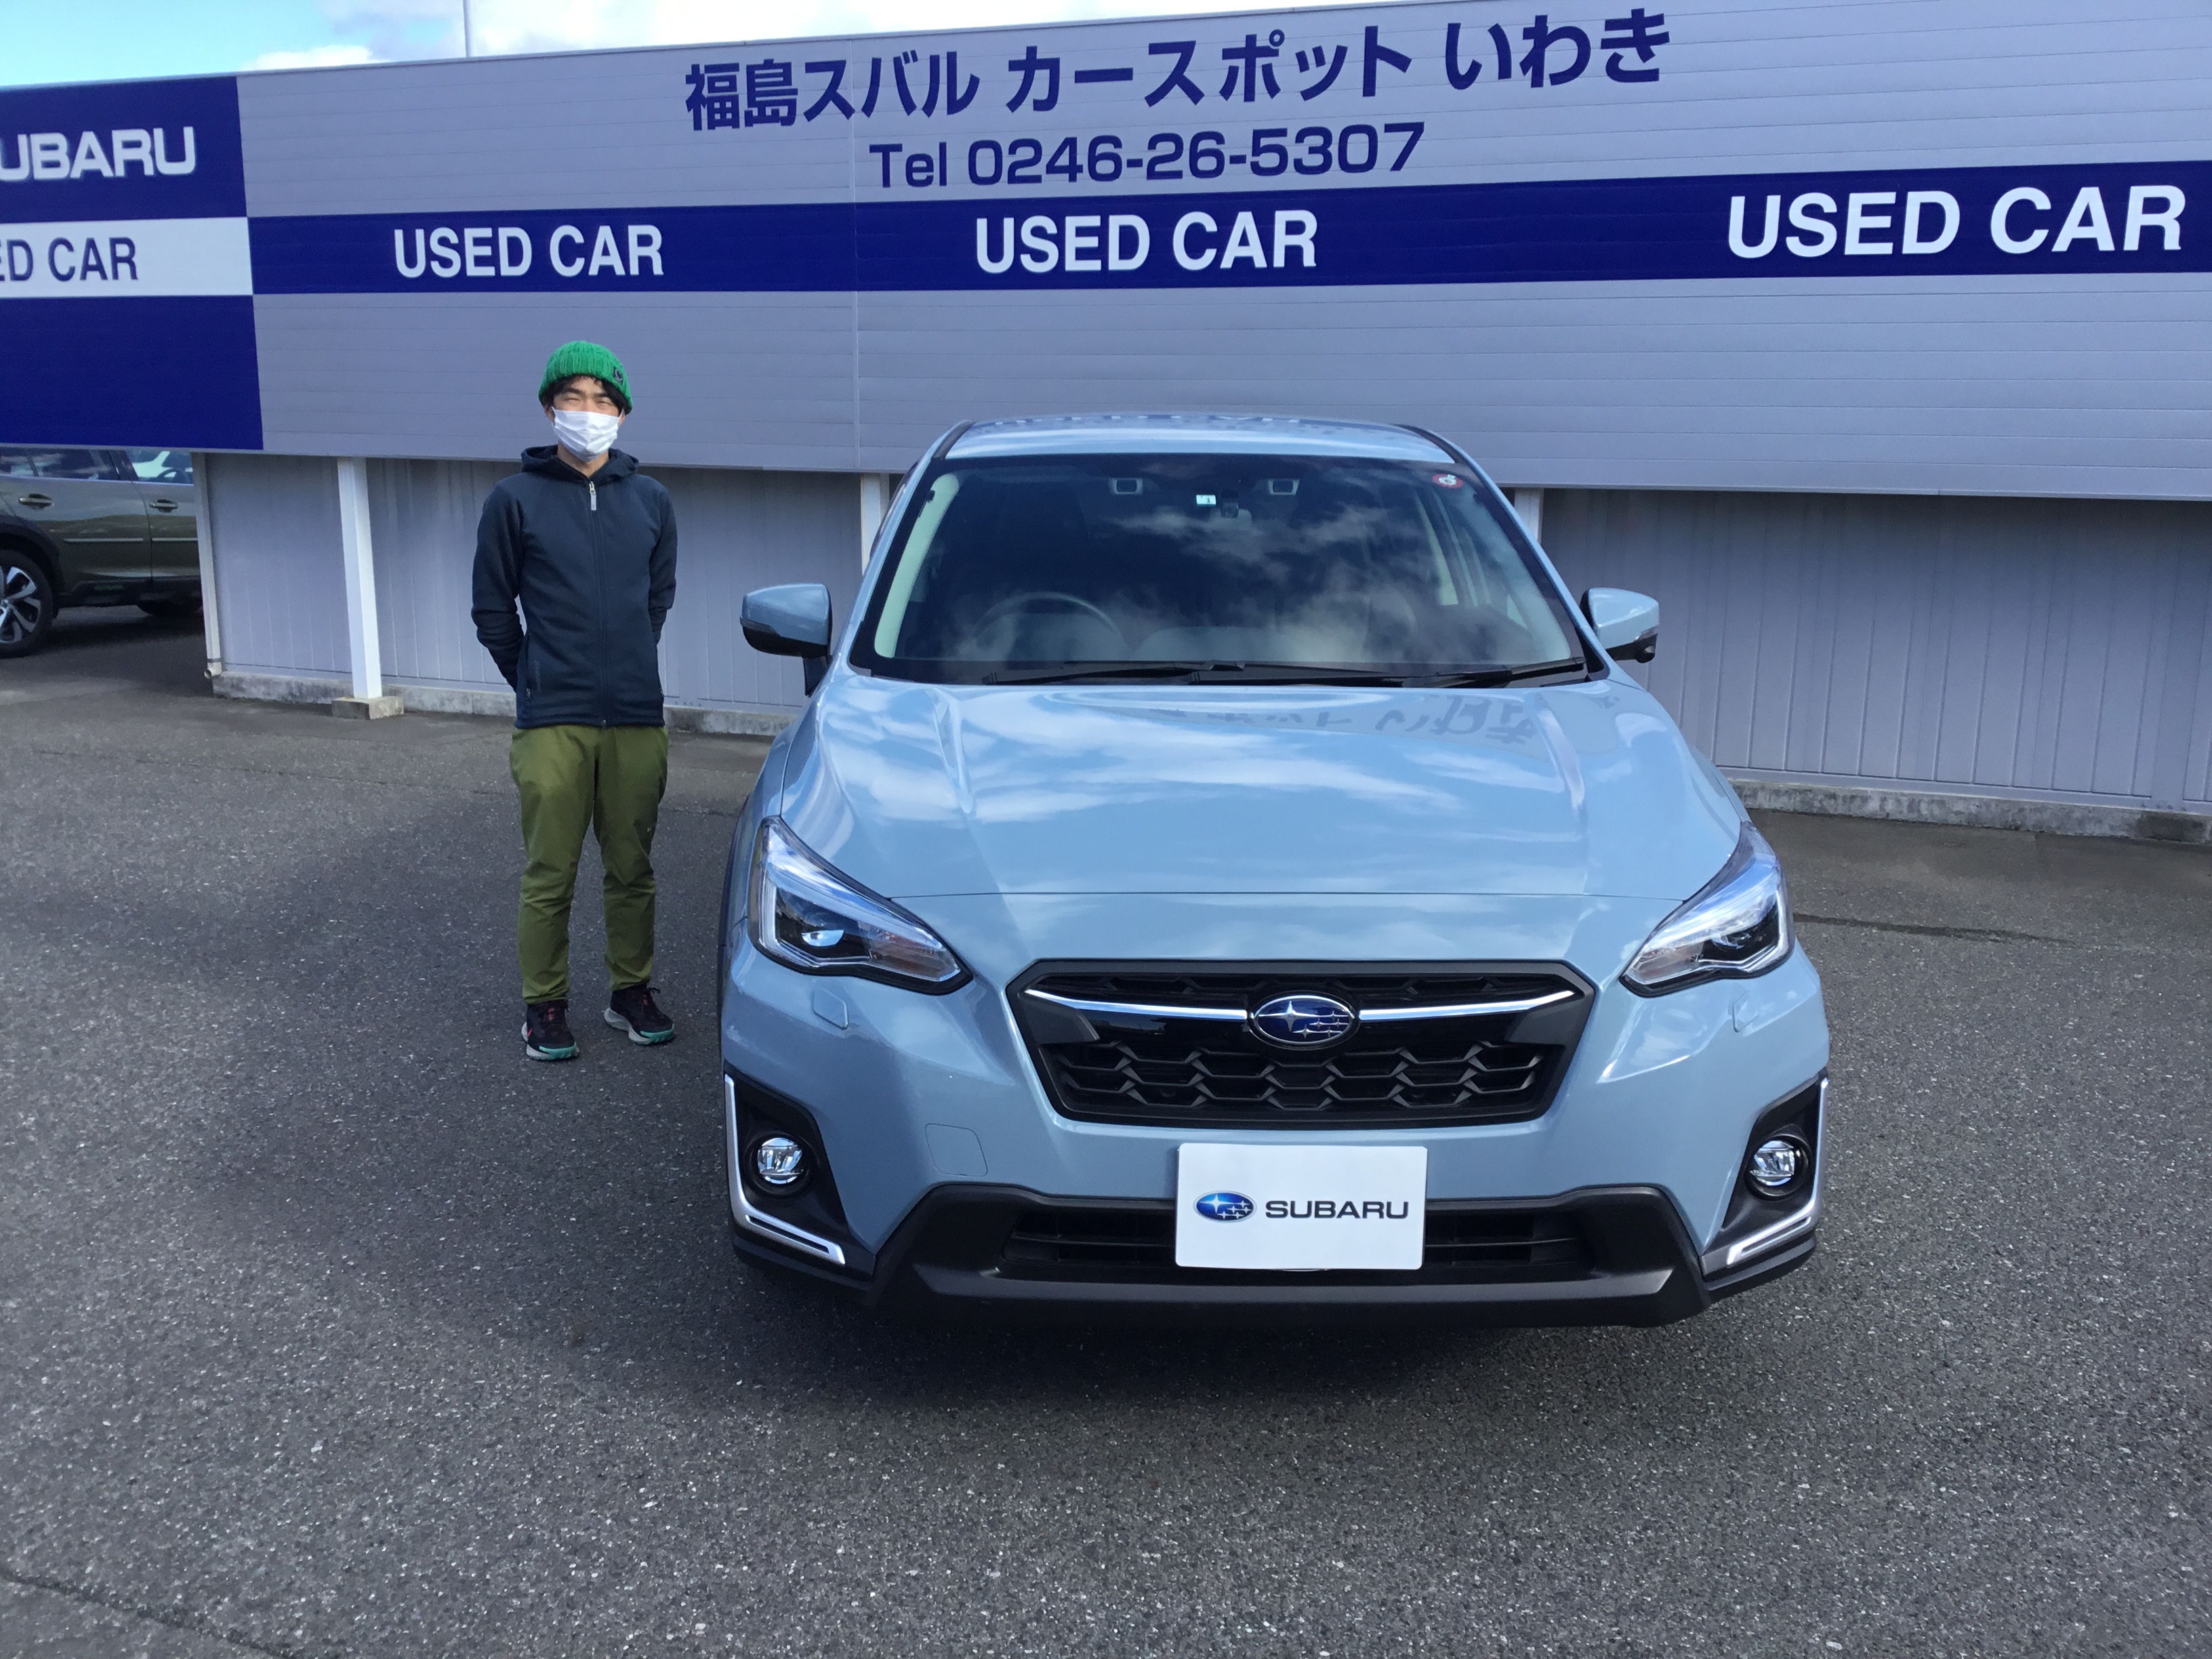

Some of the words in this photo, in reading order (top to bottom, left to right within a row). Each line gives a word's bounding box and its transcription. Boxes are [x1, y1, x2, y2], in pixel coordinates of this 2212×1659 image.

[685, 49, 981, 131] 福島スバル
[1006, 25, 1413, 113] カースポット
[1444, 7, 1671, 91] いわき
[0, 126, 197, 182] UBARU
[869, 141, 948, 188] Tel
[967, 121, 1425, 186] 0246-26-5307
[394, 226, 533, 279] USED
[549, 224, 664, 277] CAR
[975, 213, 1151, 273] USED
[1172, 209, 1319, 272] CAR
[1727, 190, 1961, 259] USED
[1990, 184, 2186, 255] CAR
[0, 239, 34, 282] D
[47, 237, 139, 282] CAR
[1265, 1200, 1409, 1219] SUBARU
